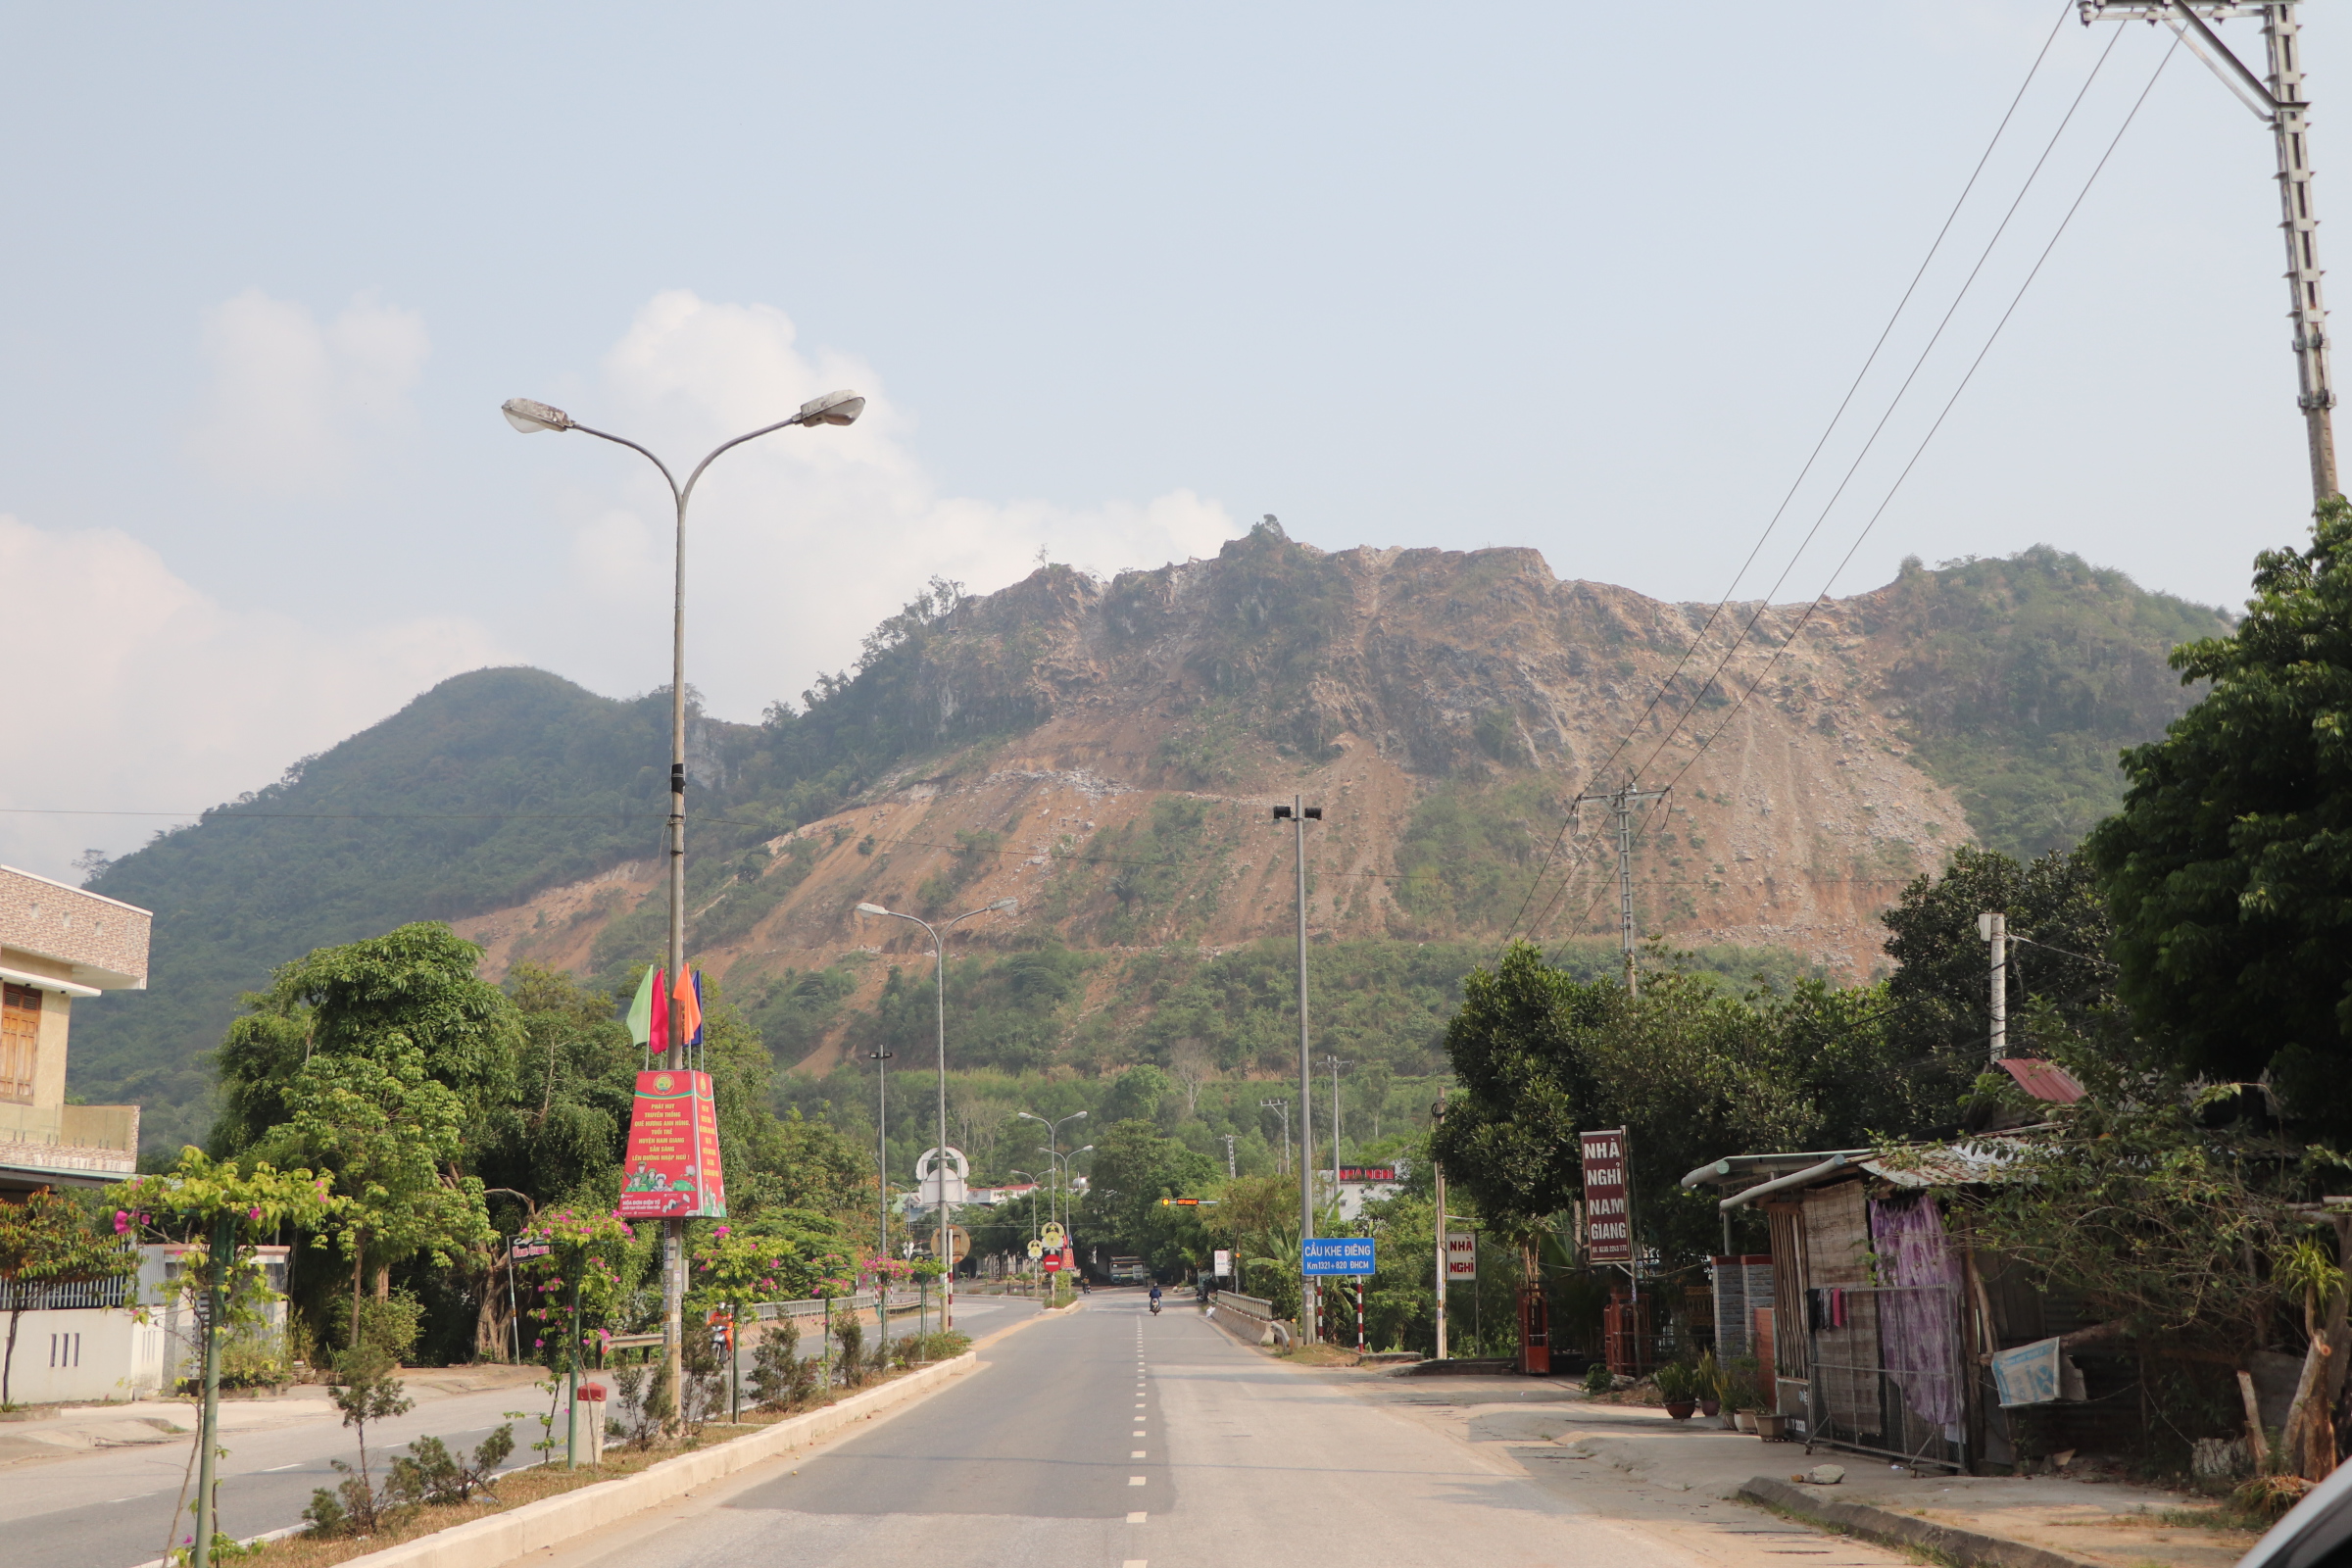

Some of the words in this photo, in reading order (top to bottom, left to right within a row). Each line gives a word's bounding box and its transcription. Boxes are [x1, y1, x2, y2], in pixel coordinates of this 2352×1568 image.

[1584, 1138, 1620, 1159] NHÀ
[1587, 1161, 1622, 1186] NGHỈ
[1589, 1198, 1625, 1215] NAM
[1304, 1241, 1323, 1257] CẦU
[1324, 1246, 1343, 1256] KHE
[1345, 1244, 1371, 1255] ĐIÊNG
[1449, 1236, 1473, 1251] NHÀ
[1349, 1260, 1369, 1269] ĐHCM
[1449, 1256, 1474, 1273] NGHỈ
